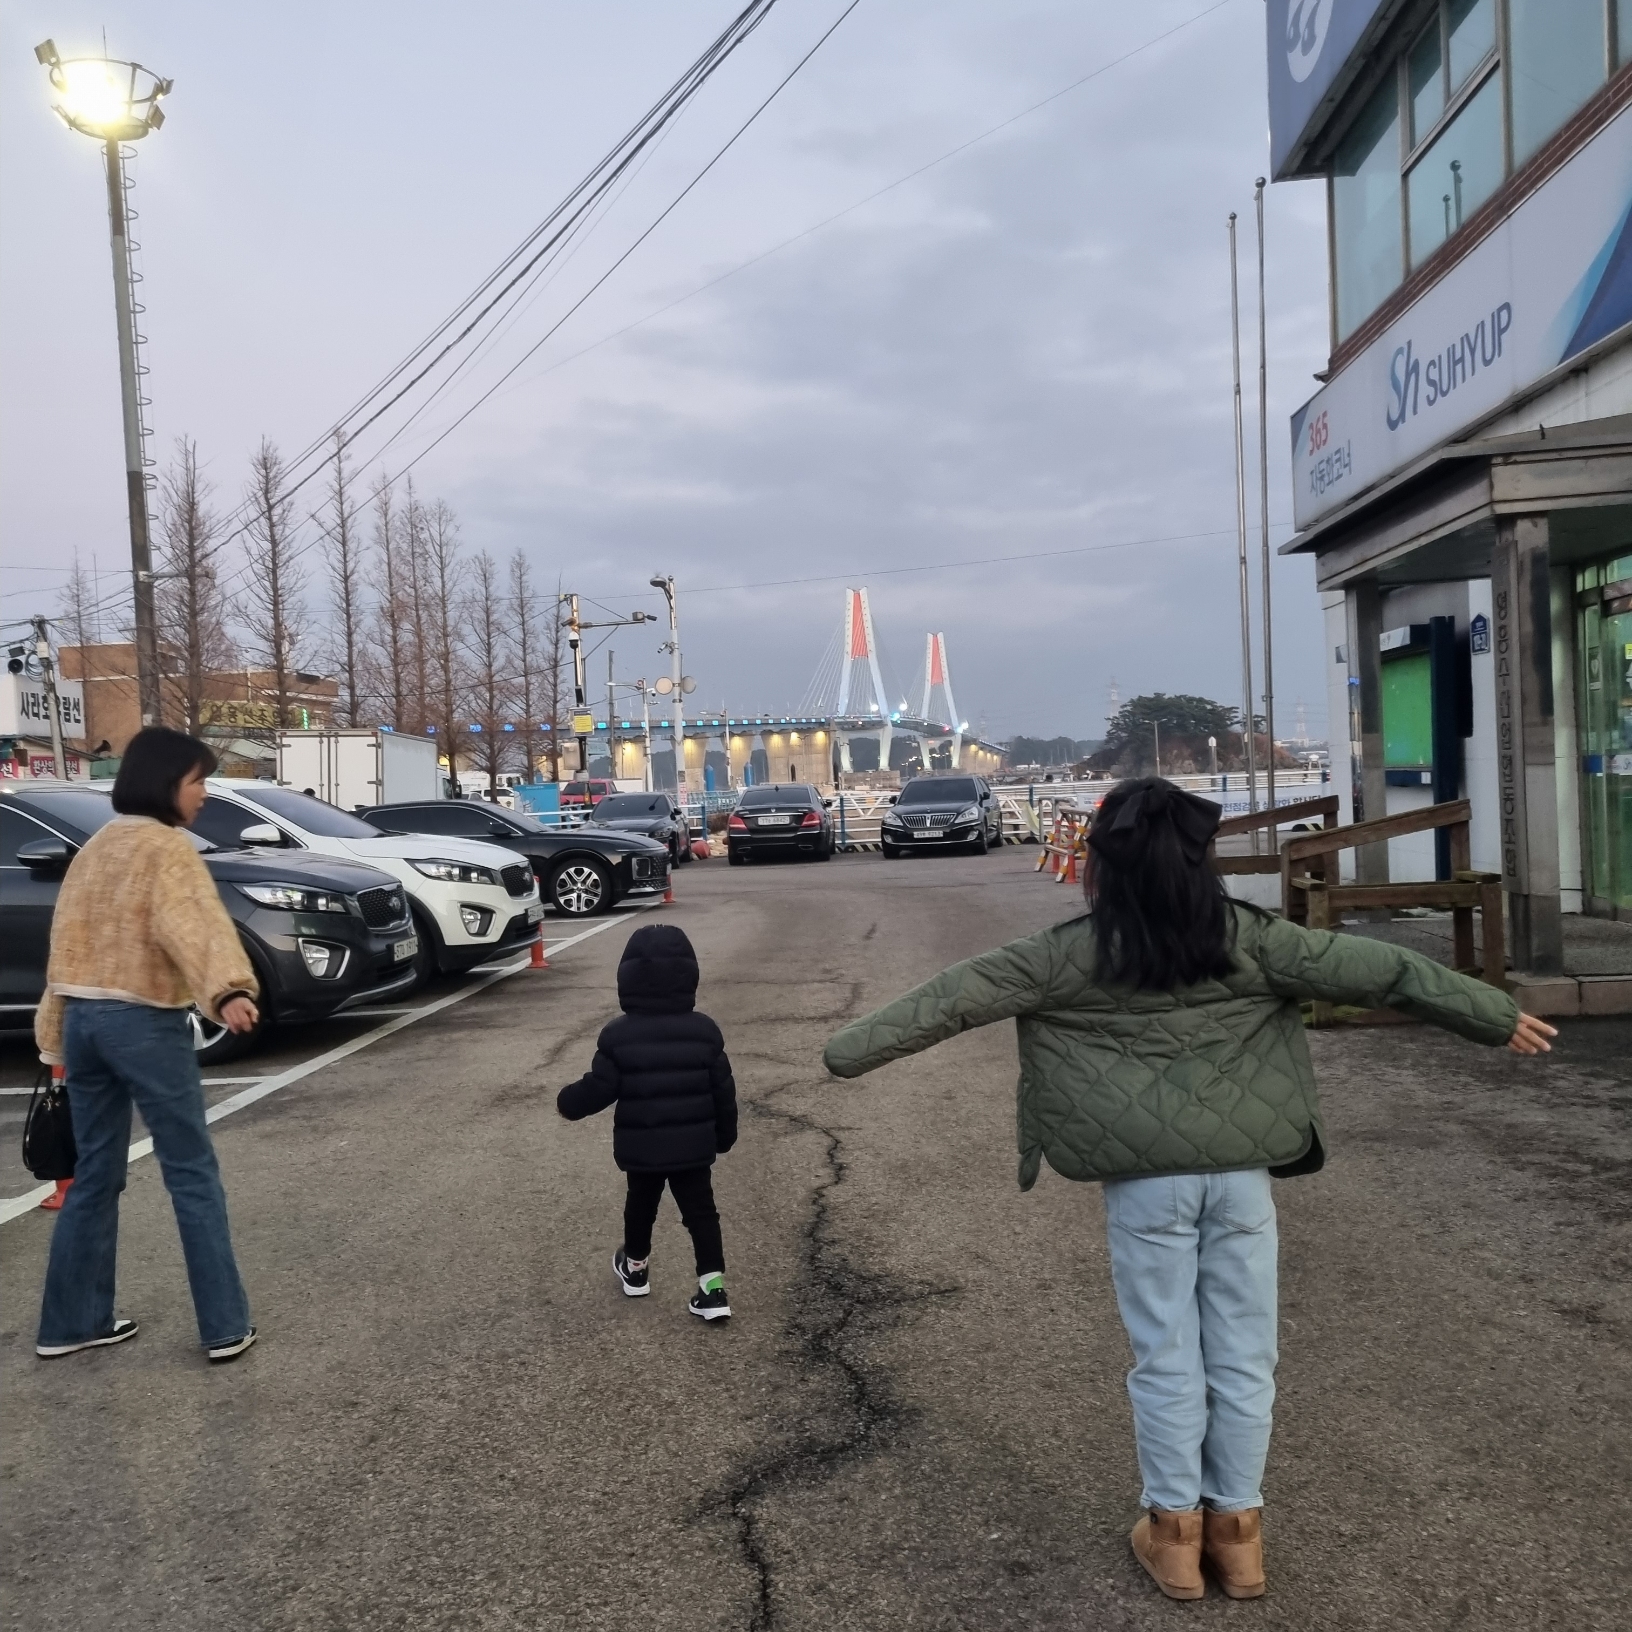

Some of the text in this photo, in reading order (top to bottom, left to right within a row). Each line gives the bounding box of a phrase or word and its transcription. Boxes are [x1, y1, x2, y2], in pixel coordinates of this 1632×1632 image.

[1386, 301, 1512, 431] Sh SUHYUP
[1308, 410, 1328, 457] 365
[1309, 438, 1352, 497] 자동화코너
[20, 691, 82, 724] 사라호람선
